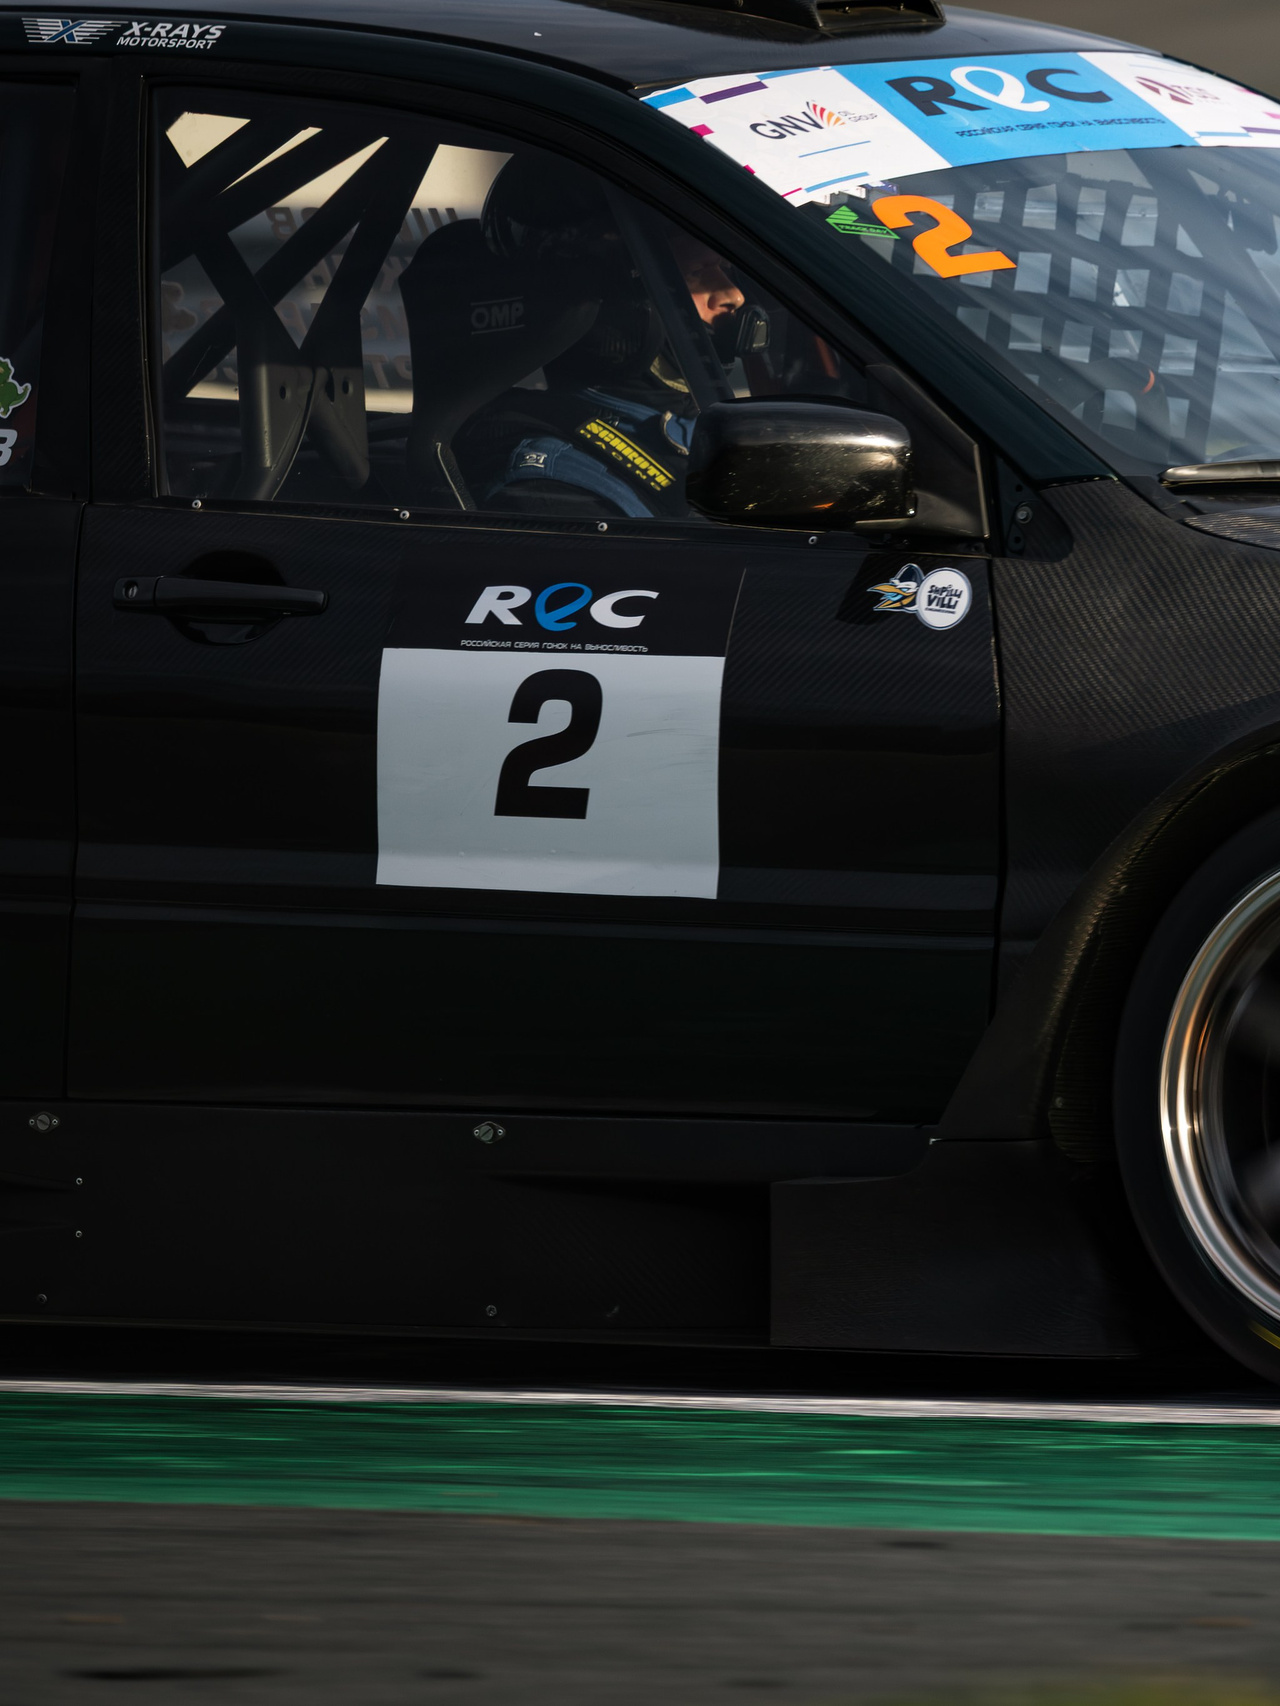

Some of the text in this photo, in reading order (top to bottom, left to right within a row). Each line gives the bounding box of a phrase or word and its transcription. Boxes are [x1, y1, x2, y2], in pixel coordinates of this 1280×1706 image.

[116, 36, 216, 50] MOTORSPORT
[122, 21, 226, 39] X-RAYS
[749, 101, 824, 139] GNV
[872, 195, 1017, 278] 2
[471, 301, 525, 329] OMP
[586, 422, 672, 488] SCHROTH
[460, 639, 649, 653] РОССИЙСКАЯ СЕРИЯ ГОНОК НА ВЫНОСЛИВОСТЬ
[494, 668, 603, 820] 2
